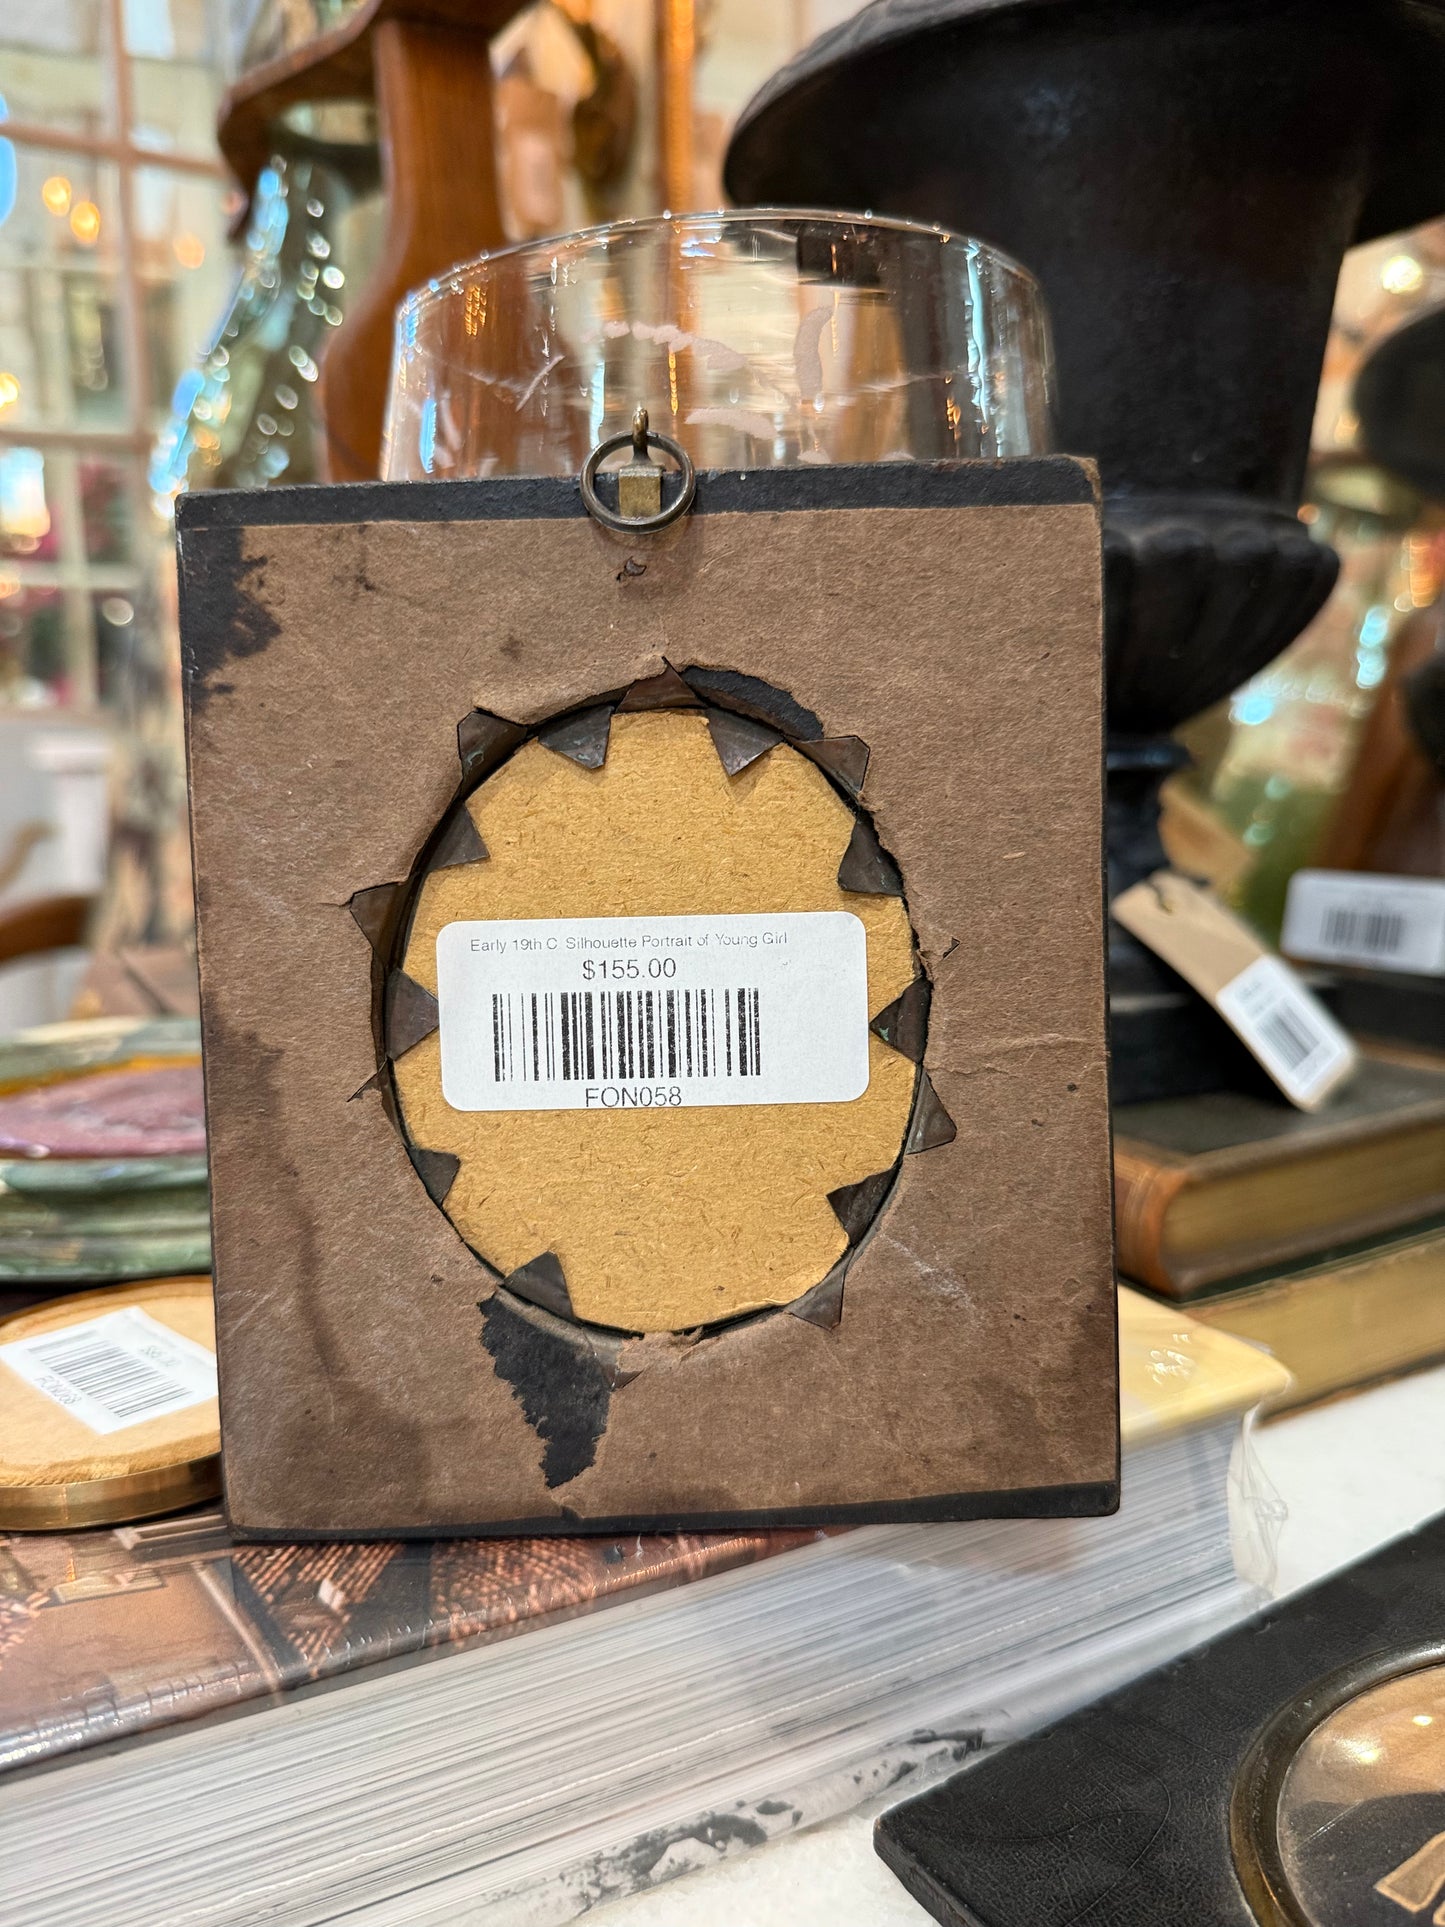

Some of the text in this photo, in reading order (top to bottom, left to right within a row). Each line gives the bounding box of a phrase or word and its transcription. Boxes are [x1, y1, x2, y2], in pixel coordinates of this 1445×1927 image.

[470, 938, 507, 954] Early
[512, 937, 542, 951] 19th
[565, 935, 637, 950] Silhouette
[642, 934, 693, 948] Portrait
[697, 933, 709, 946] of
[715, 932, 758, 948] Young
[762, 931, 788, 945] Girl
[582, 957, 677, 980] $155.00
[585, 1085, 682, 1108] FON058
